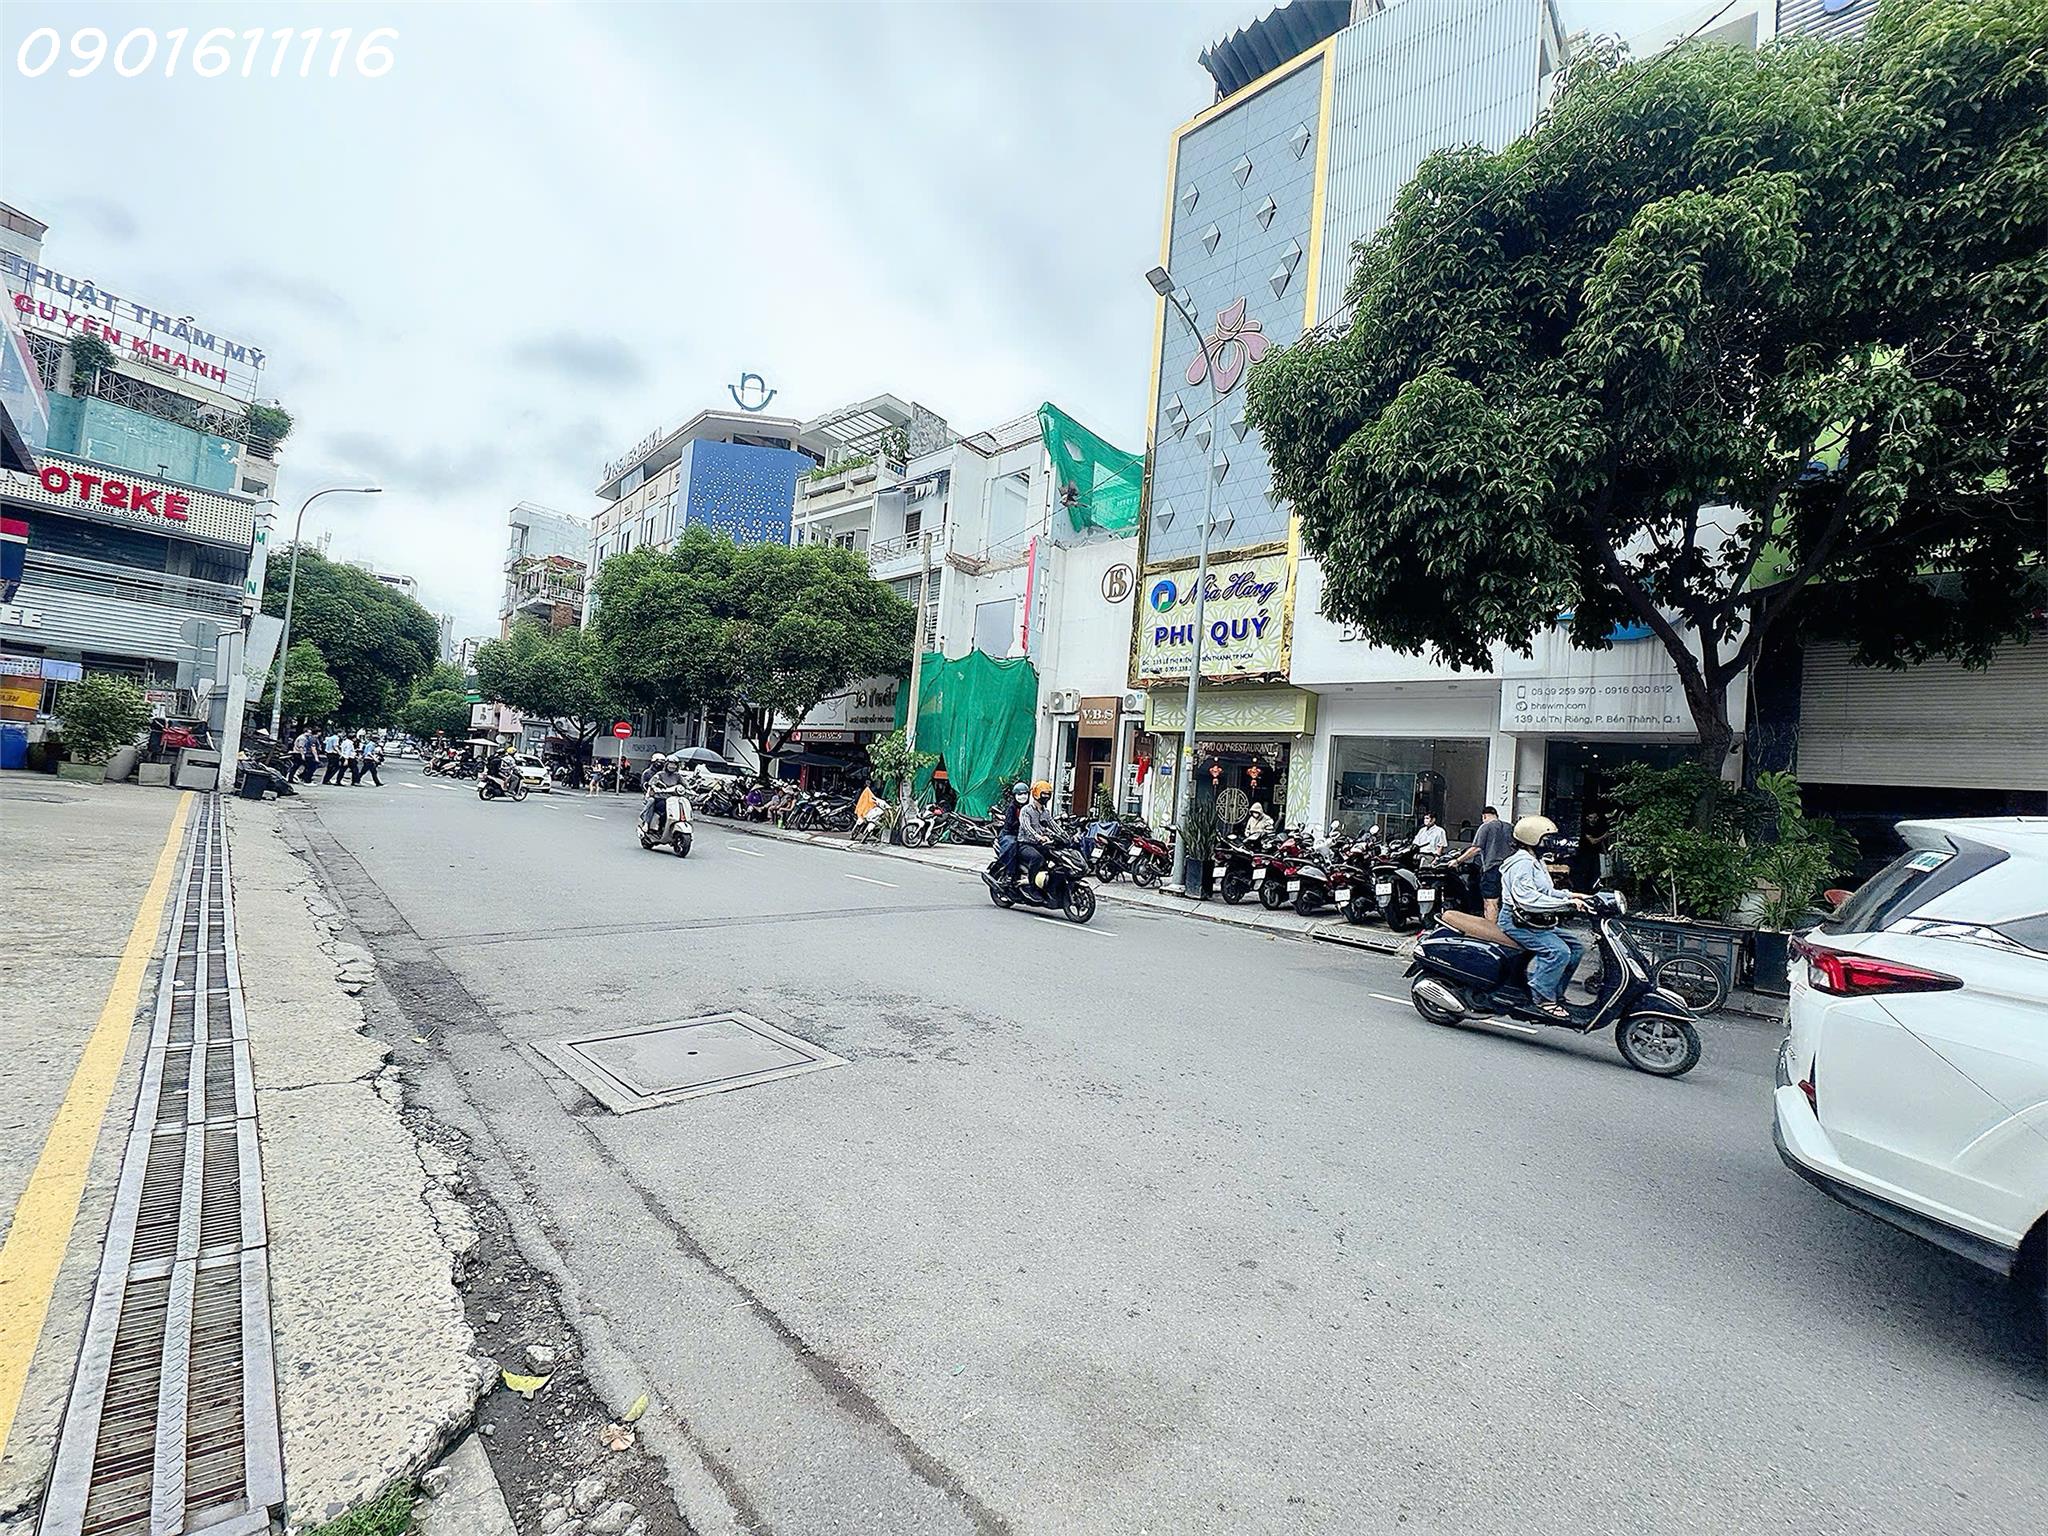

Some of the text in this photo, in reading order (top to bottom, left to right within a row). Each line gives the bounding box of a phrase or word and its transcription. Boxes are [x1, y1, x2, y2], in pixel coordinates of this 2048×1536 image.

[5, 254, 120, 311] THUẬT
[131, 303, 216, 351] THẨM
[132, 336, 228, 384] KHANH
[1222, 571, 1278, 605] Hàng
[1211, 608, 1271, 648] QUÝ
[1578, 686, 1596, 695] 970
[1605, 686, 1629, 694] 0916
[1632, 686, 1650, 694] 030
[1653, 685, 1673, 693] 812
[1514, 715, 1533, 724] 139
